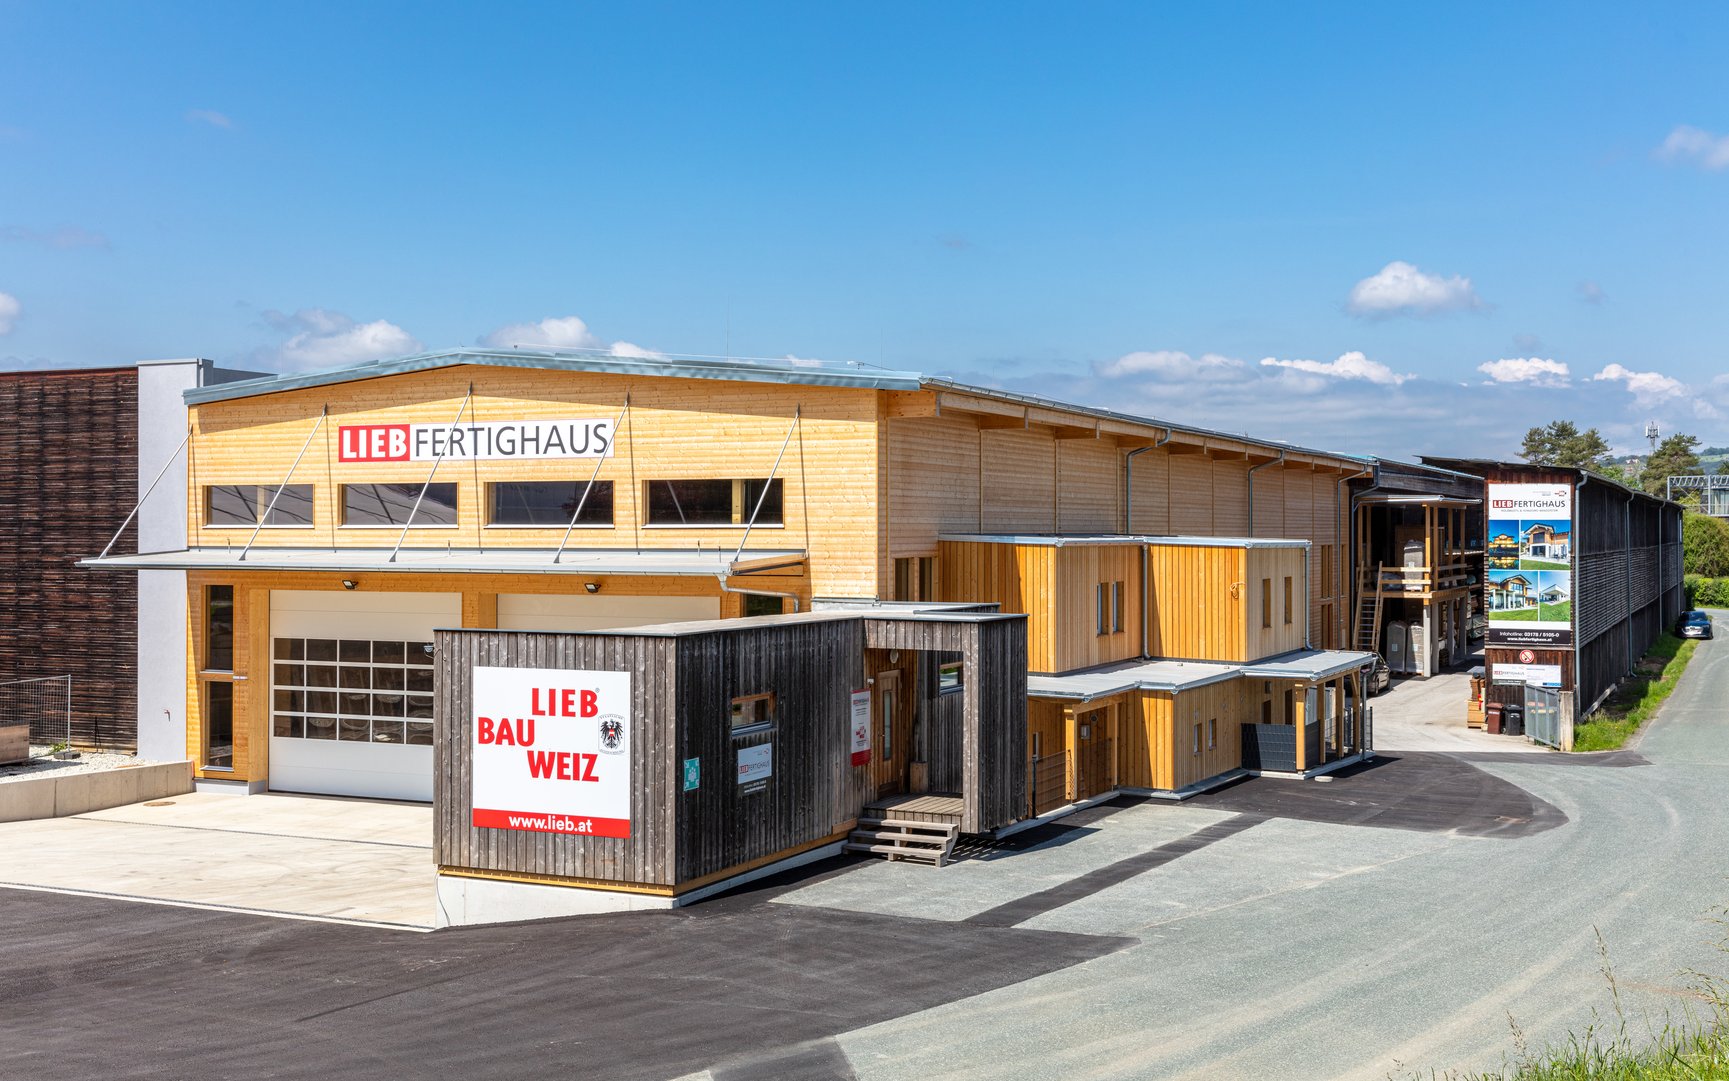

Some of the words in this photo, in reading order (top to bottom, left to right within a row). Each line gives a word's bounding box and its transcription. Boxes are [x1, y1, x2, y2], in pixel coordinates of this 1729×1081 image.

[532, 687, 599, 718] LIEB
[478, 716, 535, 747] BAU
[527, 750, 599, 782] WEIZ
[508, 815, 593, 833] www.lieb.at
